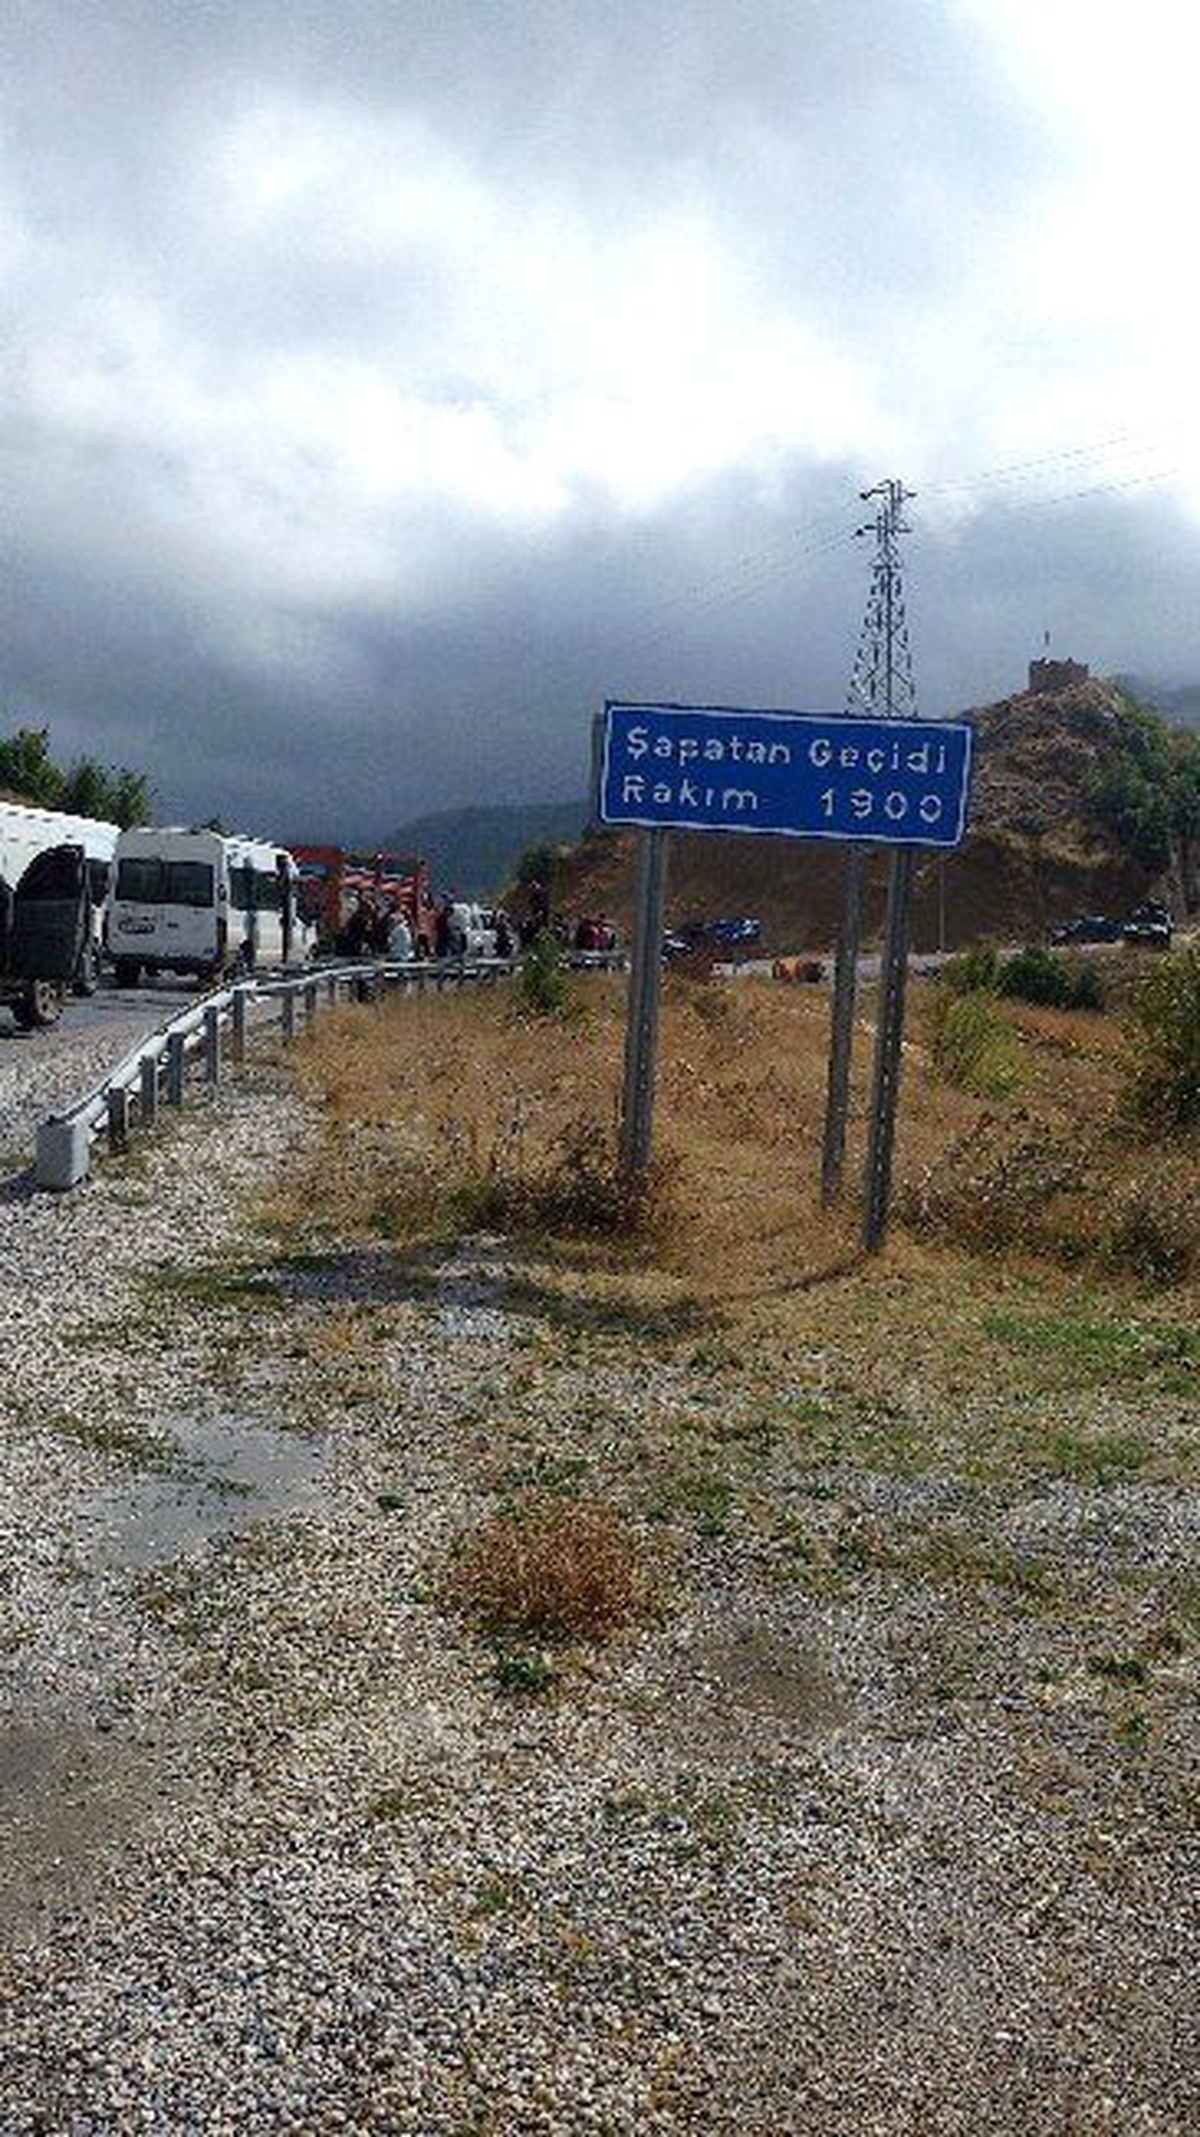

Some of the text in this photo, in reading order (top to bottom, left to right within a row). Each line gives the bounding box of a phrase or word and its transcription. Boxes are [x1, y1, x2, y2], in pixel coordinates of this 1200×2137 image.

[626, 725, 946, 774] Şapatan Geçidi
[622, 775, 942, 823] Rakım 1900
